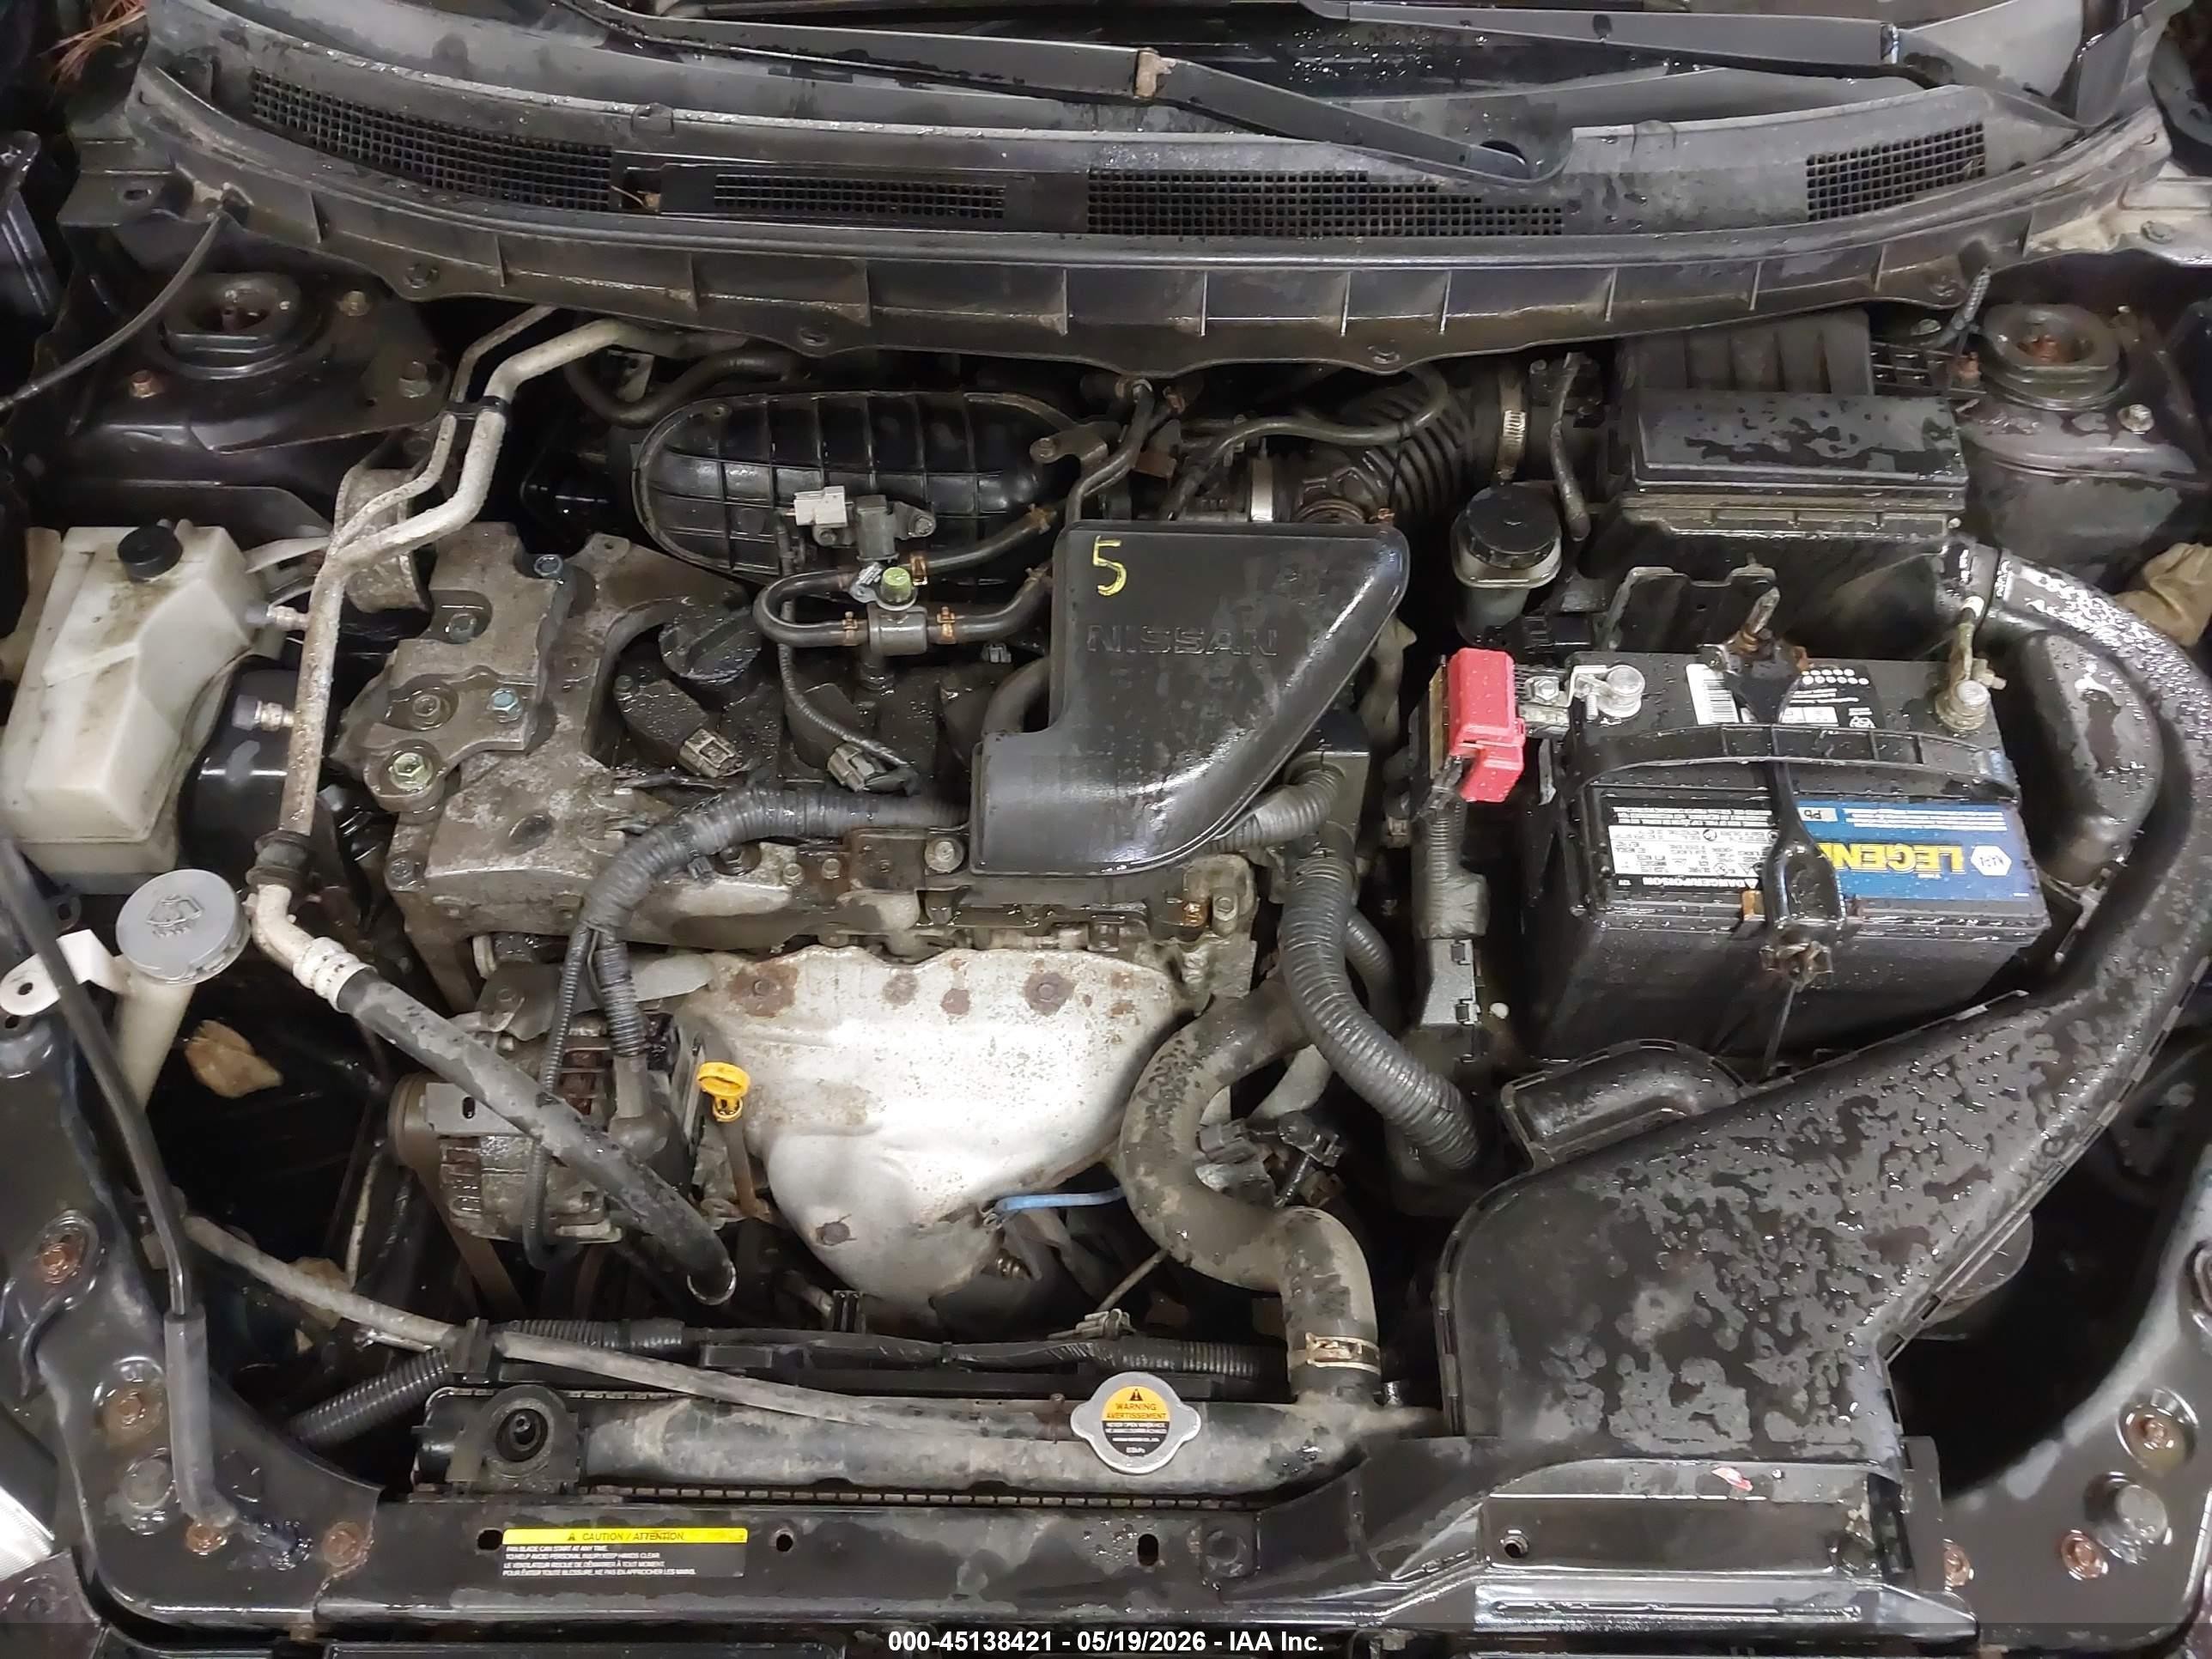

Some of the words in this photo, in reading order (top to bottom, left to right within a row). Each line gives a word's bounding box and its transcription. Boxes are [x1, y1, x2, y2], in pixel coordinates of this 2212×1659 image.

[1092, 535, 1127, 596] 5
[1086, 625, 1278, 656] NISSAN
[1115, 1402, 1158, 1411] WARNING
[582, 1532, 623, 1540] CAUTION
[631, 1532, 685, 1540] ATTENTION
